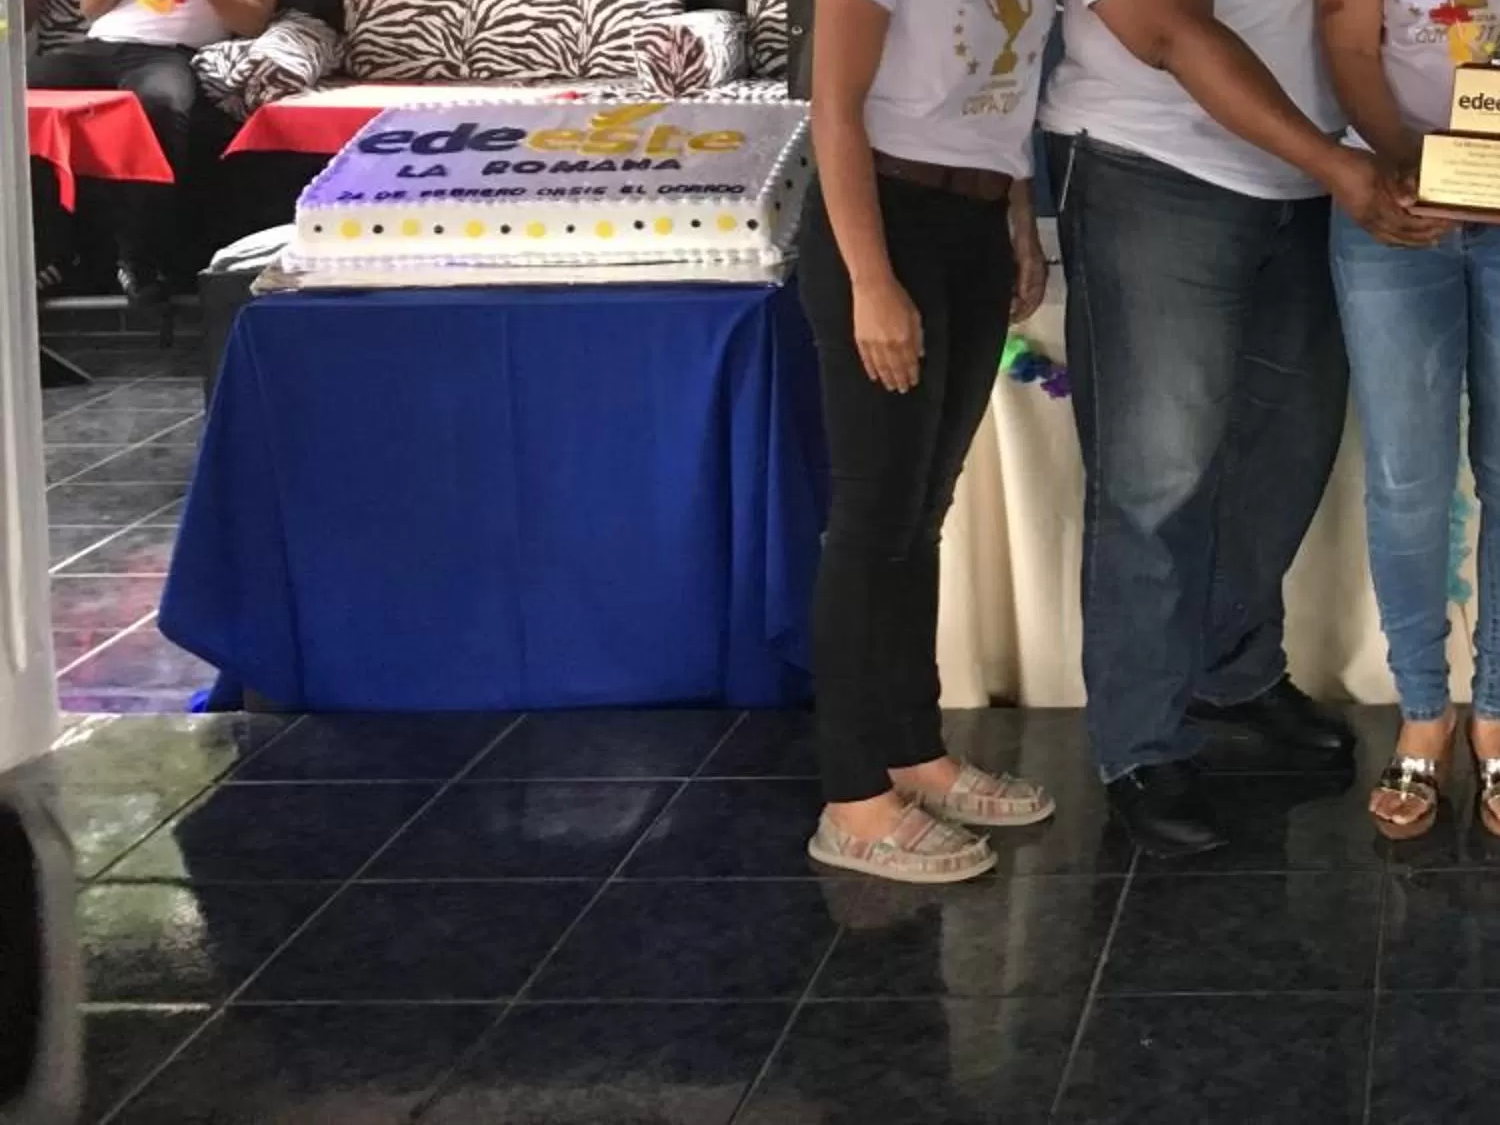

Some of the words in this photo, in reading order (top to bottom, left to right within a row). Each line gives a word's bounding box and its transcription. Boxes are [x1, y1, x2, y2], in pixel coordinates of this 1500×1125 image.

[357, 122, 746, 157] edeeste
[395, 163, 449, 179] LA
[481, 158, 682, 177] ROMANA
